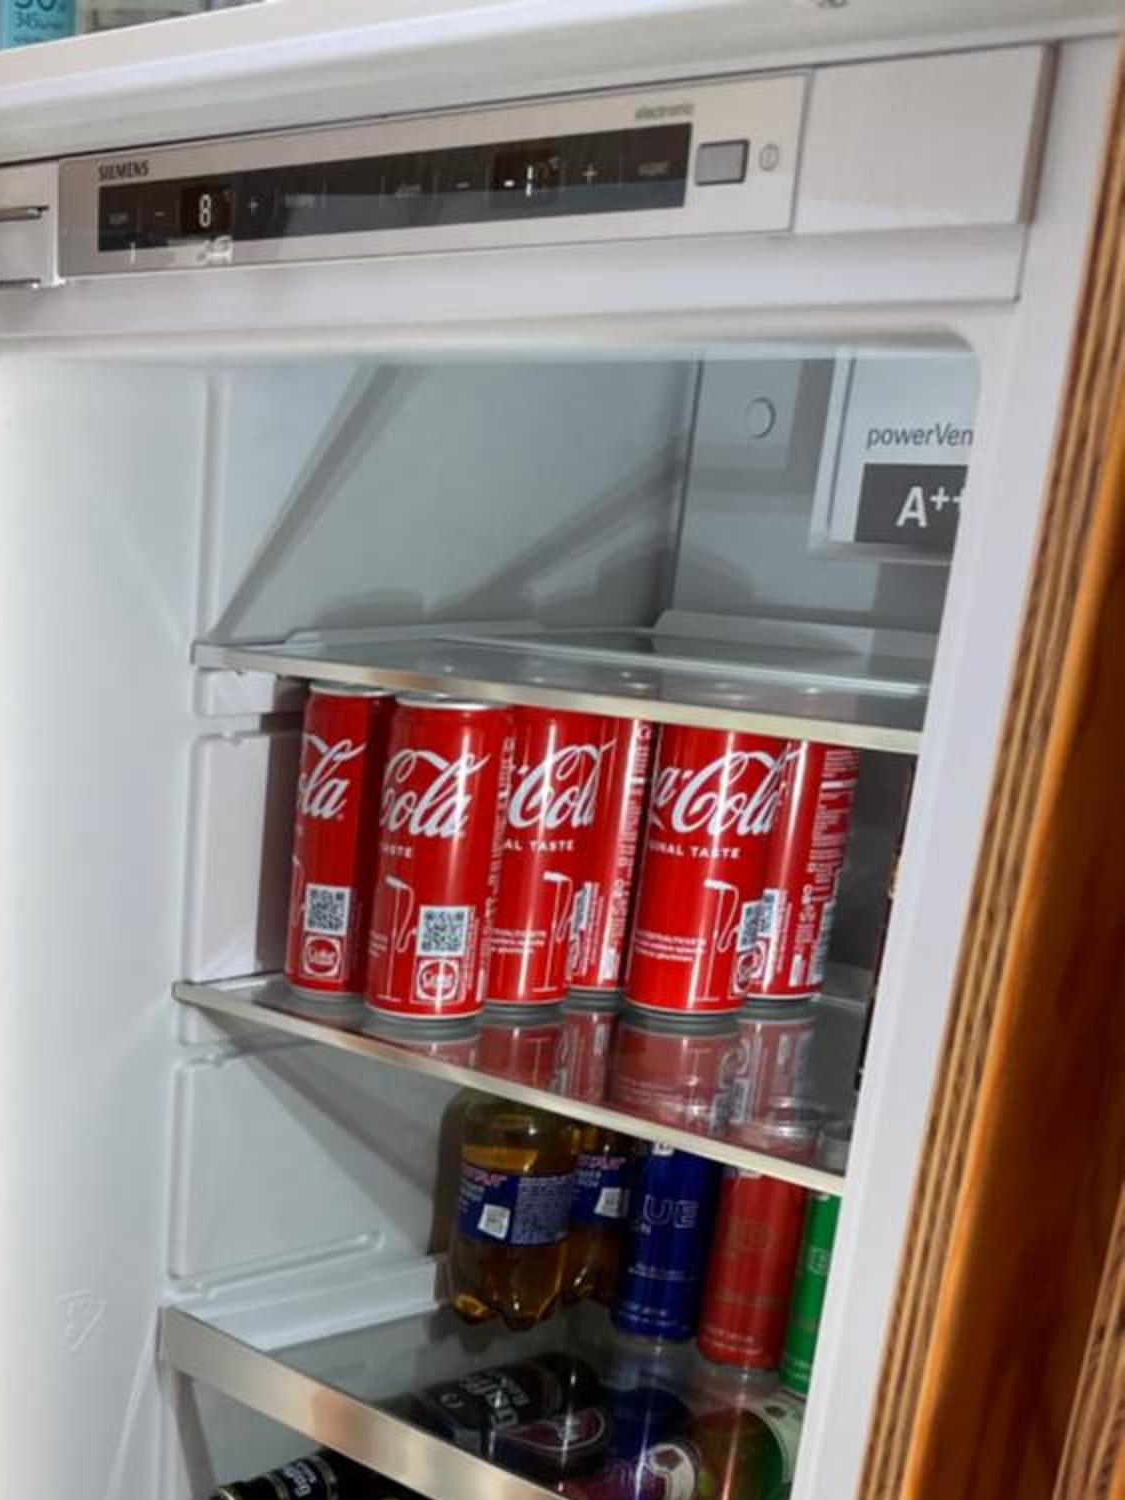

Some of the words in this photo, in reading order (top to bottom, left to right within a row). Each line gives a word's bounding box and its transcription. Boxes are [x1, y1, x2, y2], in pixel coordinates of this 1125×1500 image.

[97, 159, 151, 182] SIEMENS
[198, 193, 213, 228] 8
[529, 839, 575, 852] TASTE
[690, 846, 742, 860] TASTE
